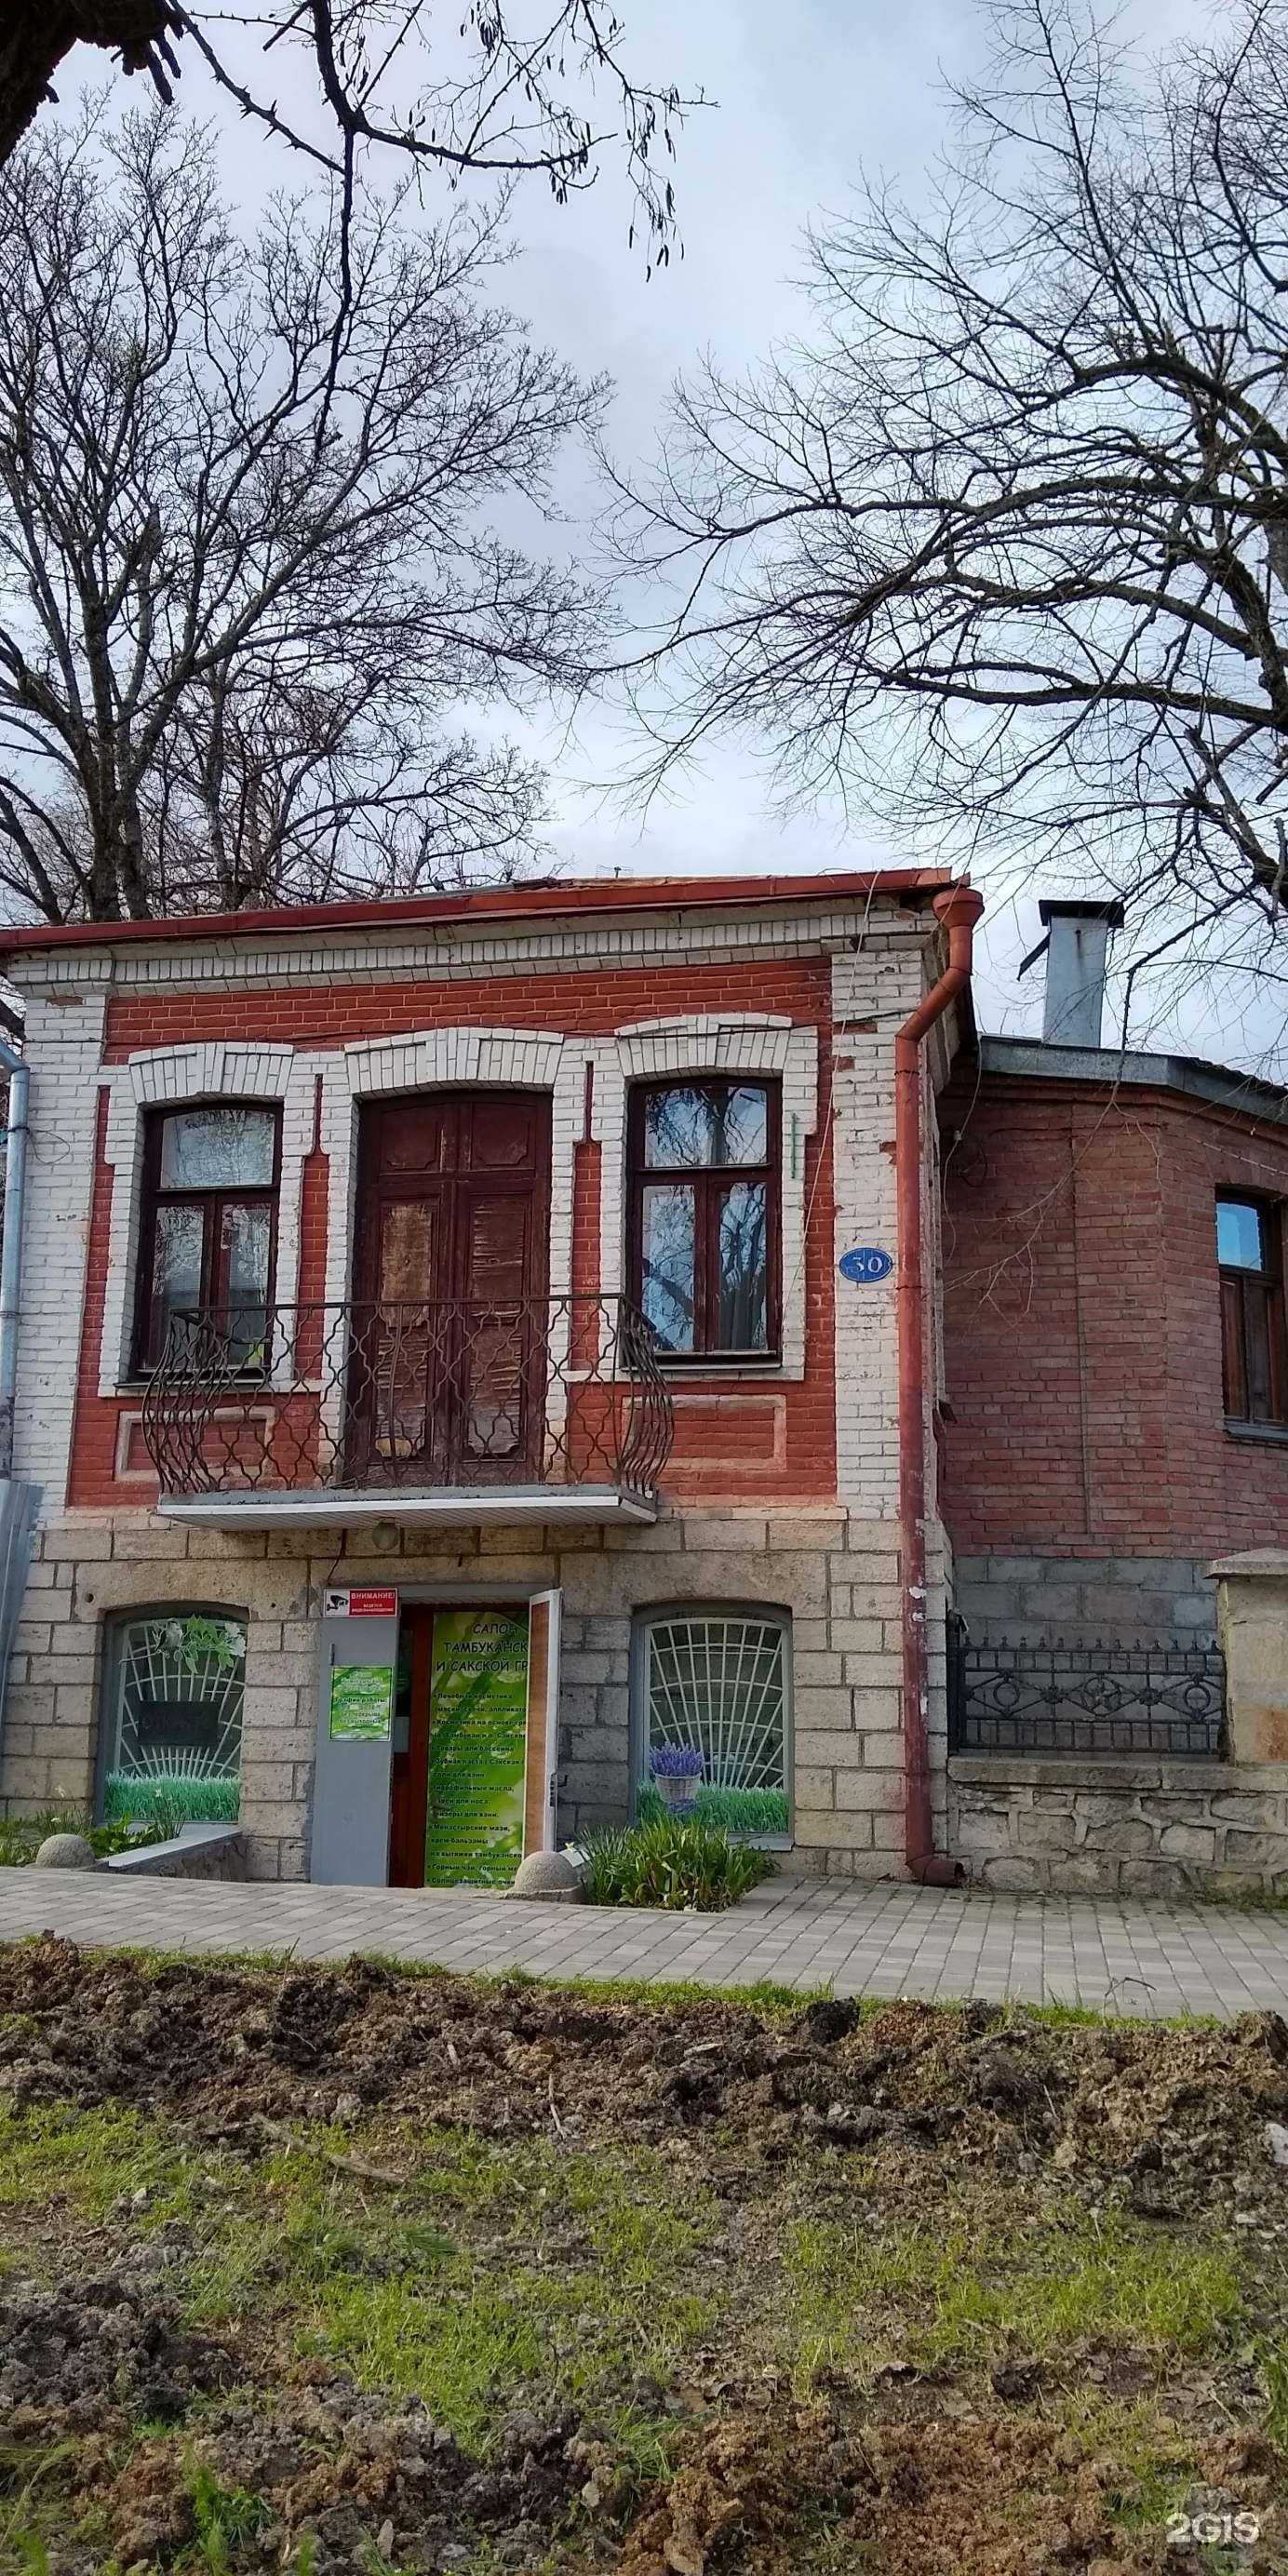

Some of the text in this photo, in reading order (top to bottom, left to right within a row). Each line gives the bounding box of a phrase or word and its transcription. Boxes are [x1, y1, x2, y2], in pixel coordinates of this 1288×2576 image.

[851, 1256, 883, 1273] 30
[473, 1623, 517, 1634] САЛОН
[443, 1642, 528, 1653] ТАМБУКАНСК
[436, 1661, 446, 1671] И
[450, 1657, 509, 1671] САКСКОЙ
